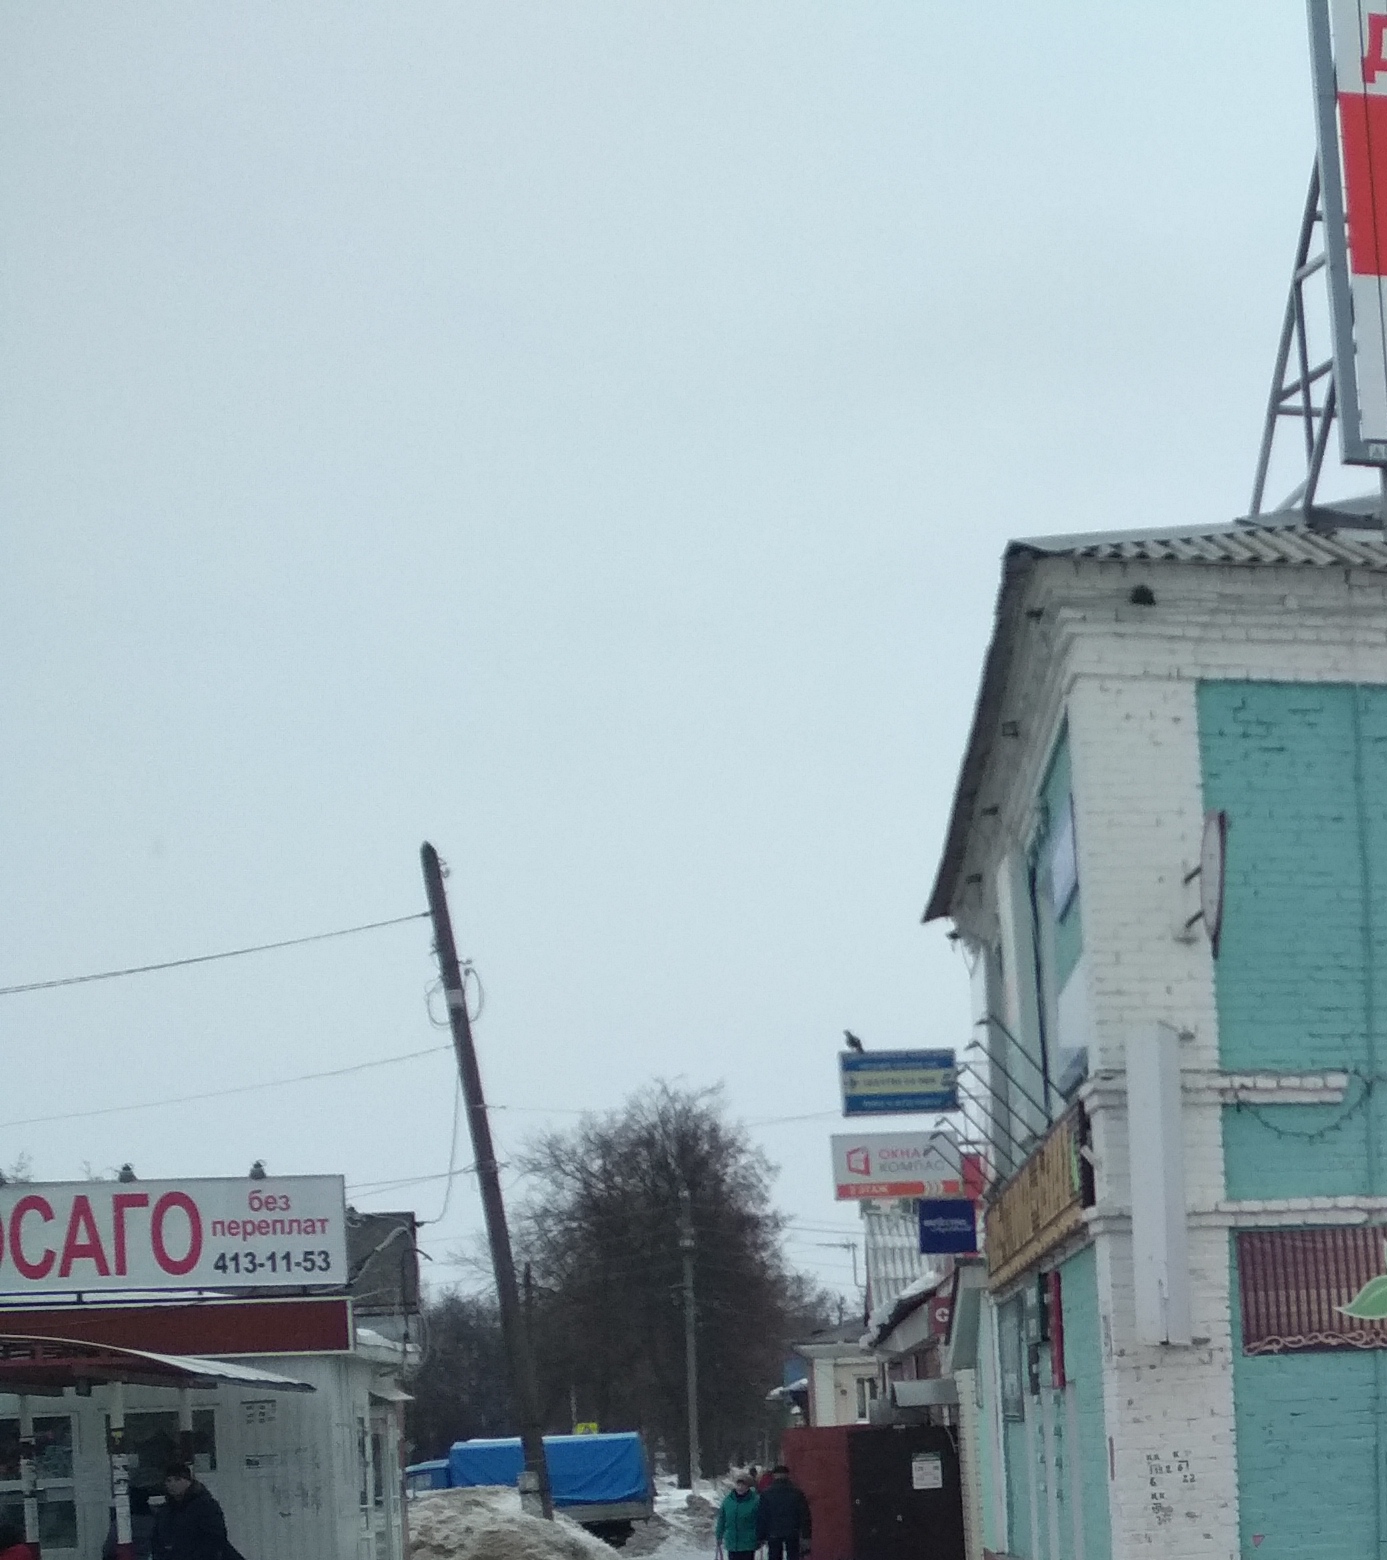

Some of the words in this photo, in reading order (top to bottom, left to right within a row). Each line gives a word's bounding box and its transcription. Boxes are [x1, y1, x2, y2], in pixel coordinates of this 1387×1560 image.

[249, 1189, 291, 1212] без
[0, 1191, 203, 1281] САГО
[211, 1218, 330, 1241] переплат
[212, 1250, 331, 1274] 413-11-53
